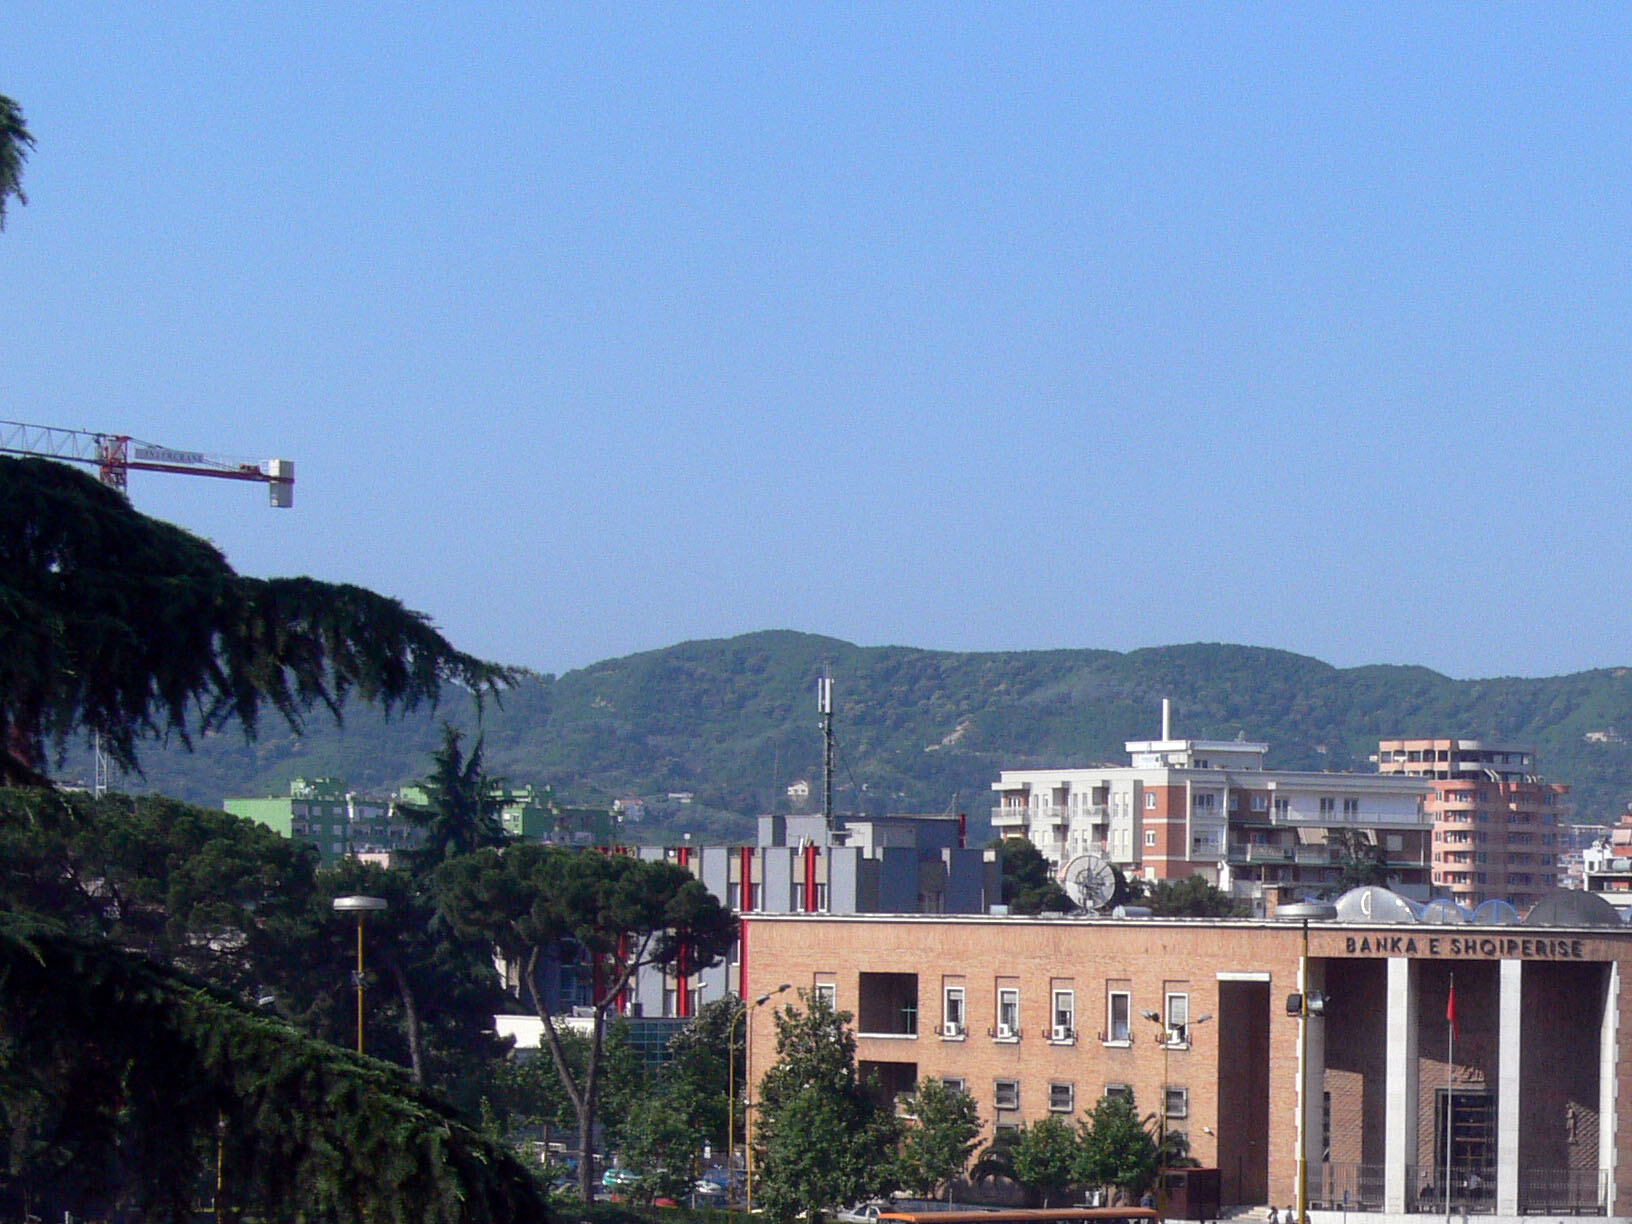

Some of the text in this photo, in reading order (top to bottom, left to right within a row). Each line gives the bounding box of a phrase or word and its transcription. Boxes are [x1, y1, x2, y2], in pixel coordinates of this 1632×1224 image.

[1346, 937, 1585, 958] BANKA E SHQIPERISE
